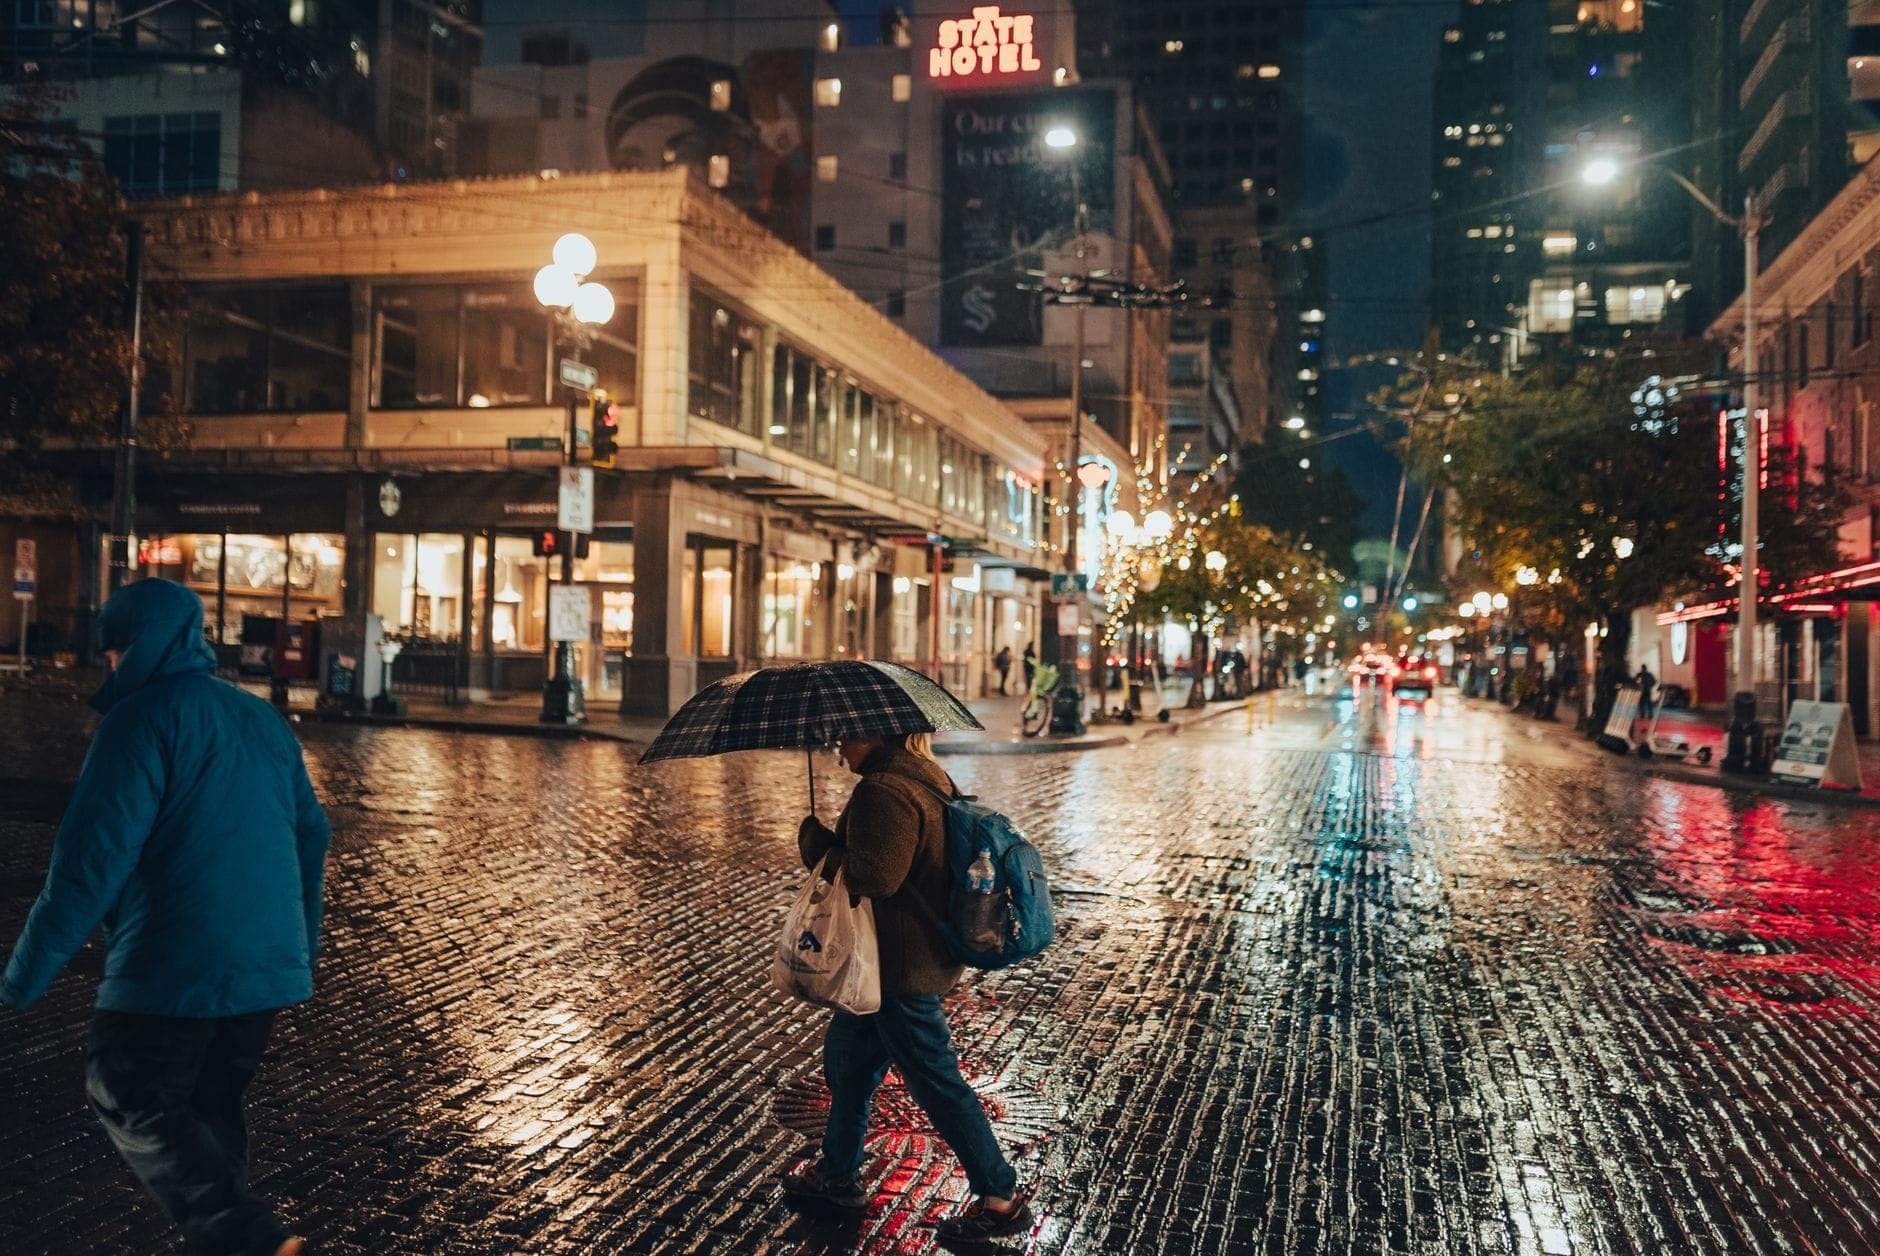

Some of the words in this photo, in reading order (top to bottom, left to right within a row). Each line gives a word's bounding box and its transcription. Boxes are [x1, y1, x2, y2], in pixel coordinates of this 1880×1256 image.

[938, 6, 1034, 48] STATE
[929, 42, 1041, 77] HOTEL
[954, 111, 1004, 135] Our
